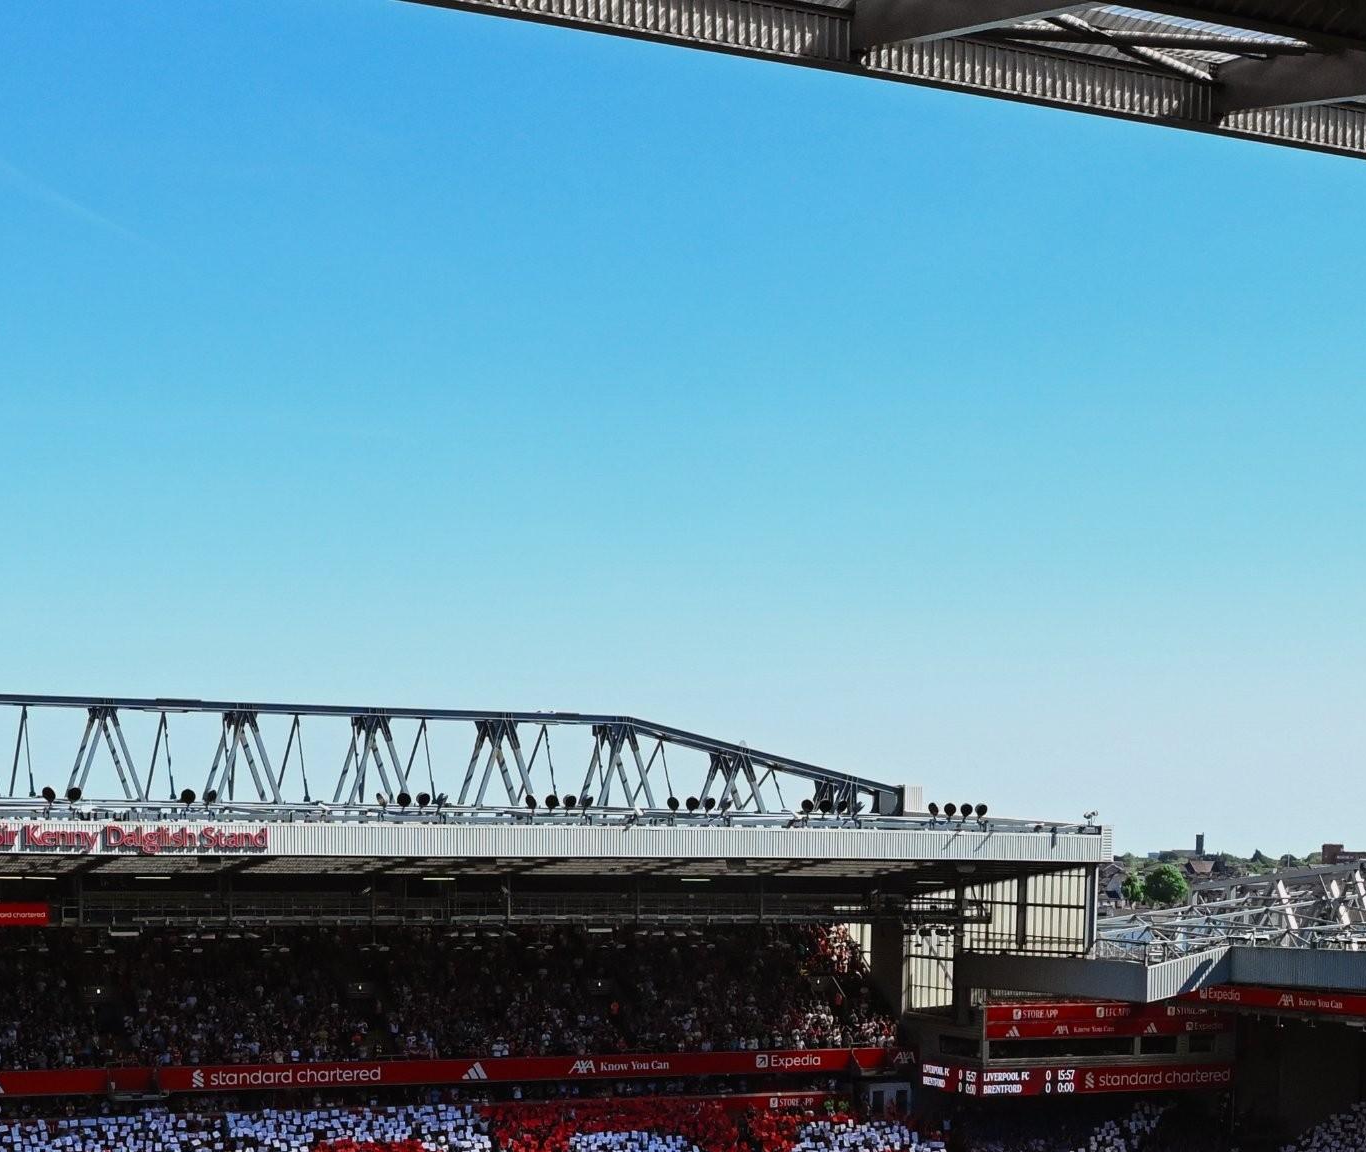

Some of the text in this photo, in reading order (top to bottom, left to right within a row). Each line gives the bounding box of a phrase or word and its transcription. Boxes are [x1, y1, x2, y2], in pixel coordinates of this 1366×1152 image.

[24, 826, 98, 851] Kenny
[105, 826, 197, 854] Dalglish
[201, 827, 268, 848] Stand
[1277, 993, 1343, 1009] AXA Know You Can
[568, 1060, 669, 1074] AXA Know You Can
[771, 1055, 821, 1069] Expedia
[210, 1067, 381, 1085] standard chartered
[983, 1070, 1075, 1081] LIVERPOOL FC 0 15:57
[1098, 1068, 1231, 1088] standard chartered
[983, 1084, 1022, 1094] BRENTFORD
